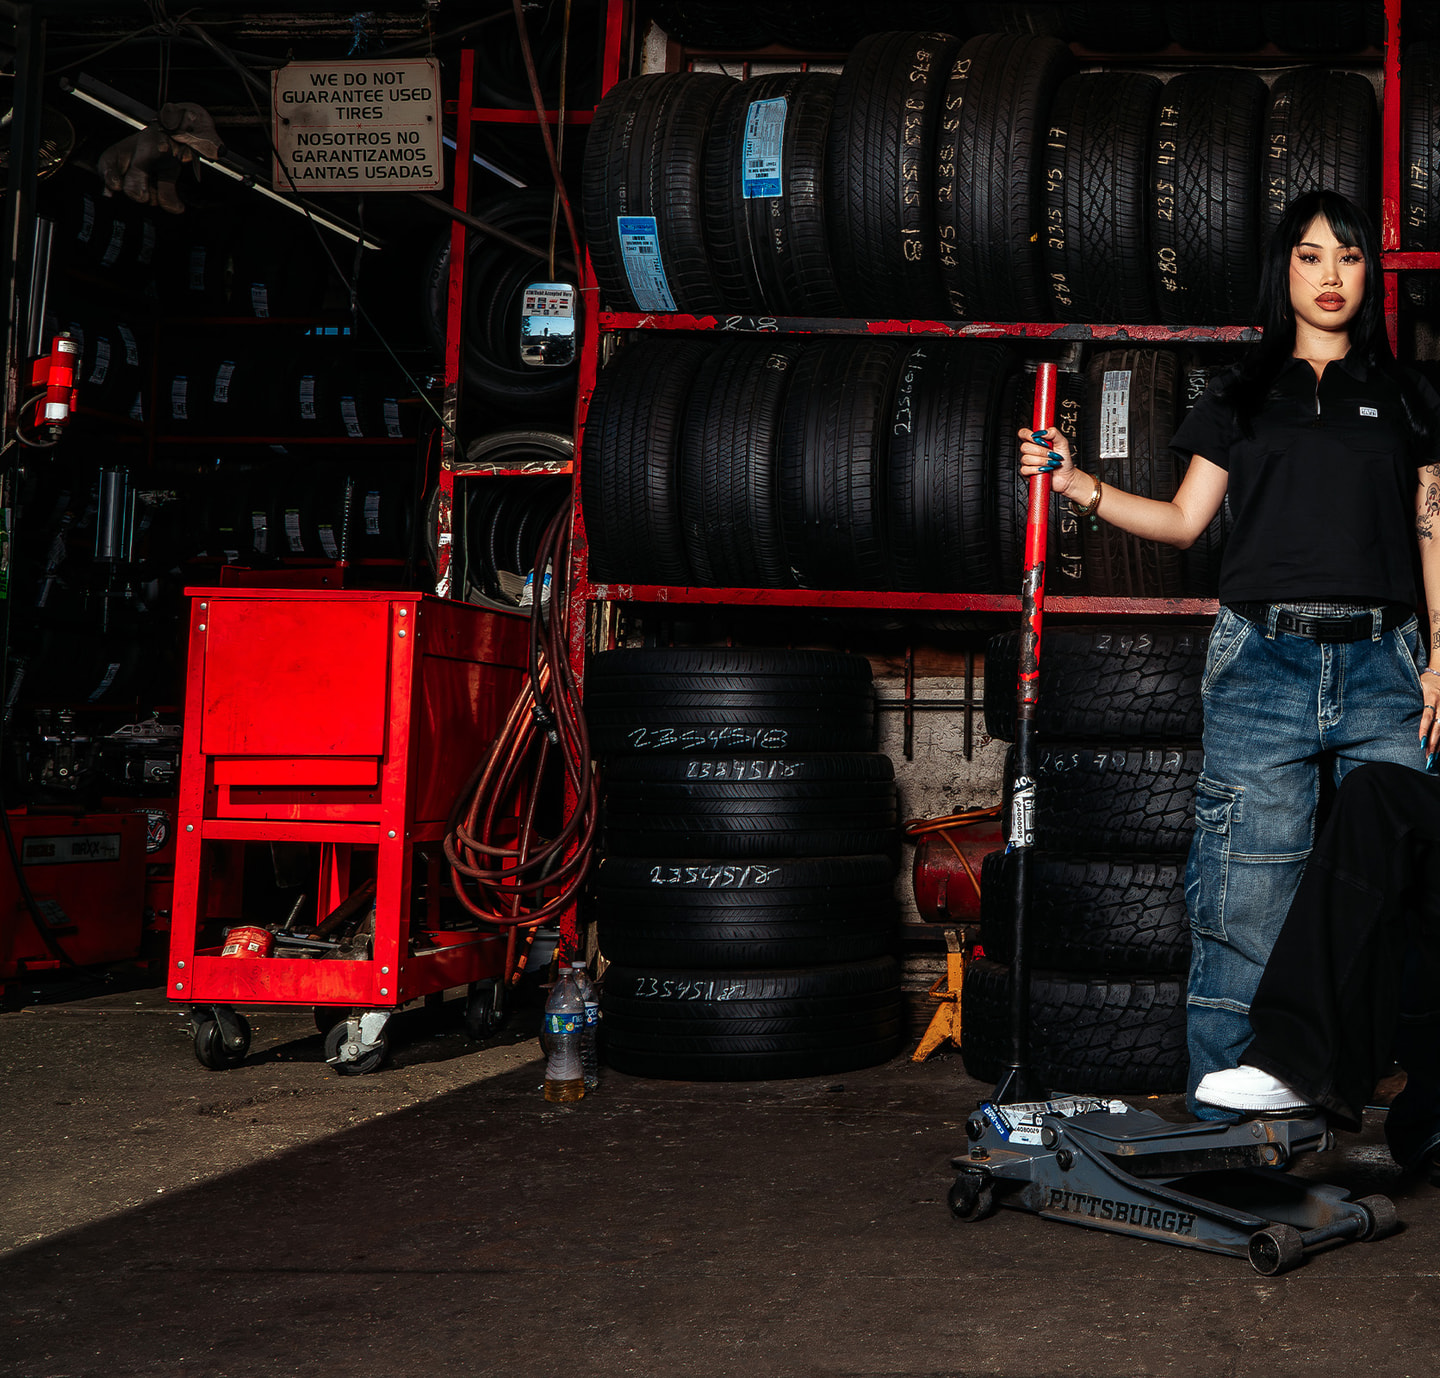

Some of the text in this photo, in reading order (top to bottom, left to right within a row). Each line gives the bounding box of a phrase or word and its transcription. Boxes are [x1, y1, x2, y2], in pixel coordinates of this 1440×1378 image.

[310, 72, 405, 86] WE DO NOT
[282, 88, 431, 103] GUARANTEE USED
[336, 106, 383, 120] TIRES
[1159, 104, 1180, 127] 17
[297, 131, 420, 146] NOSOTROS NO
[1047, 127, 1068, 149] 17
[1268, 133, 1288, 159] 45
[292, 148, 426, 162] GARANTIZAMOS
[1157, 140, 1177, 165] 45
[286, 165, 433, 180] LLANTAS USADAS
[1046, 167, 1063, 192] 45
[1410, 159, 1429, 190] 17
[1156, 179, 1176, 221] 235
[1409, 204, 1427, 228] 45
[1048, 207, 1065, 250] 235
[1049, 1189, 1196, 1237] PITTSBURGH
